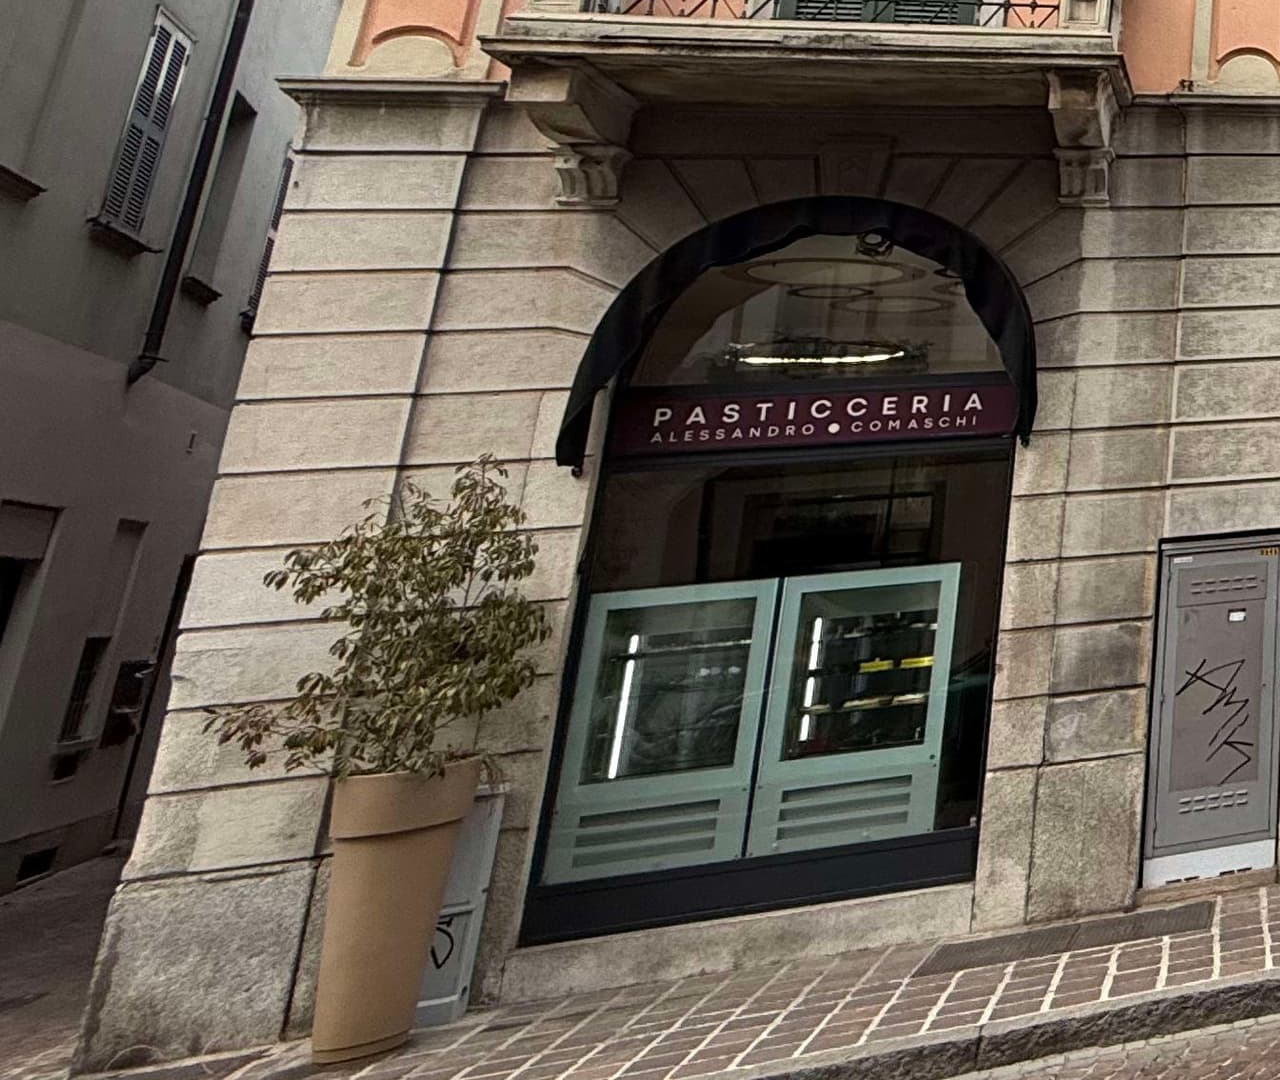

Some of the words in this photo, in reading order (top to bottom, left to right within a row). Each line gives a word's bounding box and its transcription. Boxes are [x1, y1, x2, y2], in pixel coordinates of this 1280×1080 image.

[653, 393, 983, 427] PASTICCERIA
[650, 423, 815, 444] ALESSANDRO
[850, 415, 978, 433] COMASCHI
